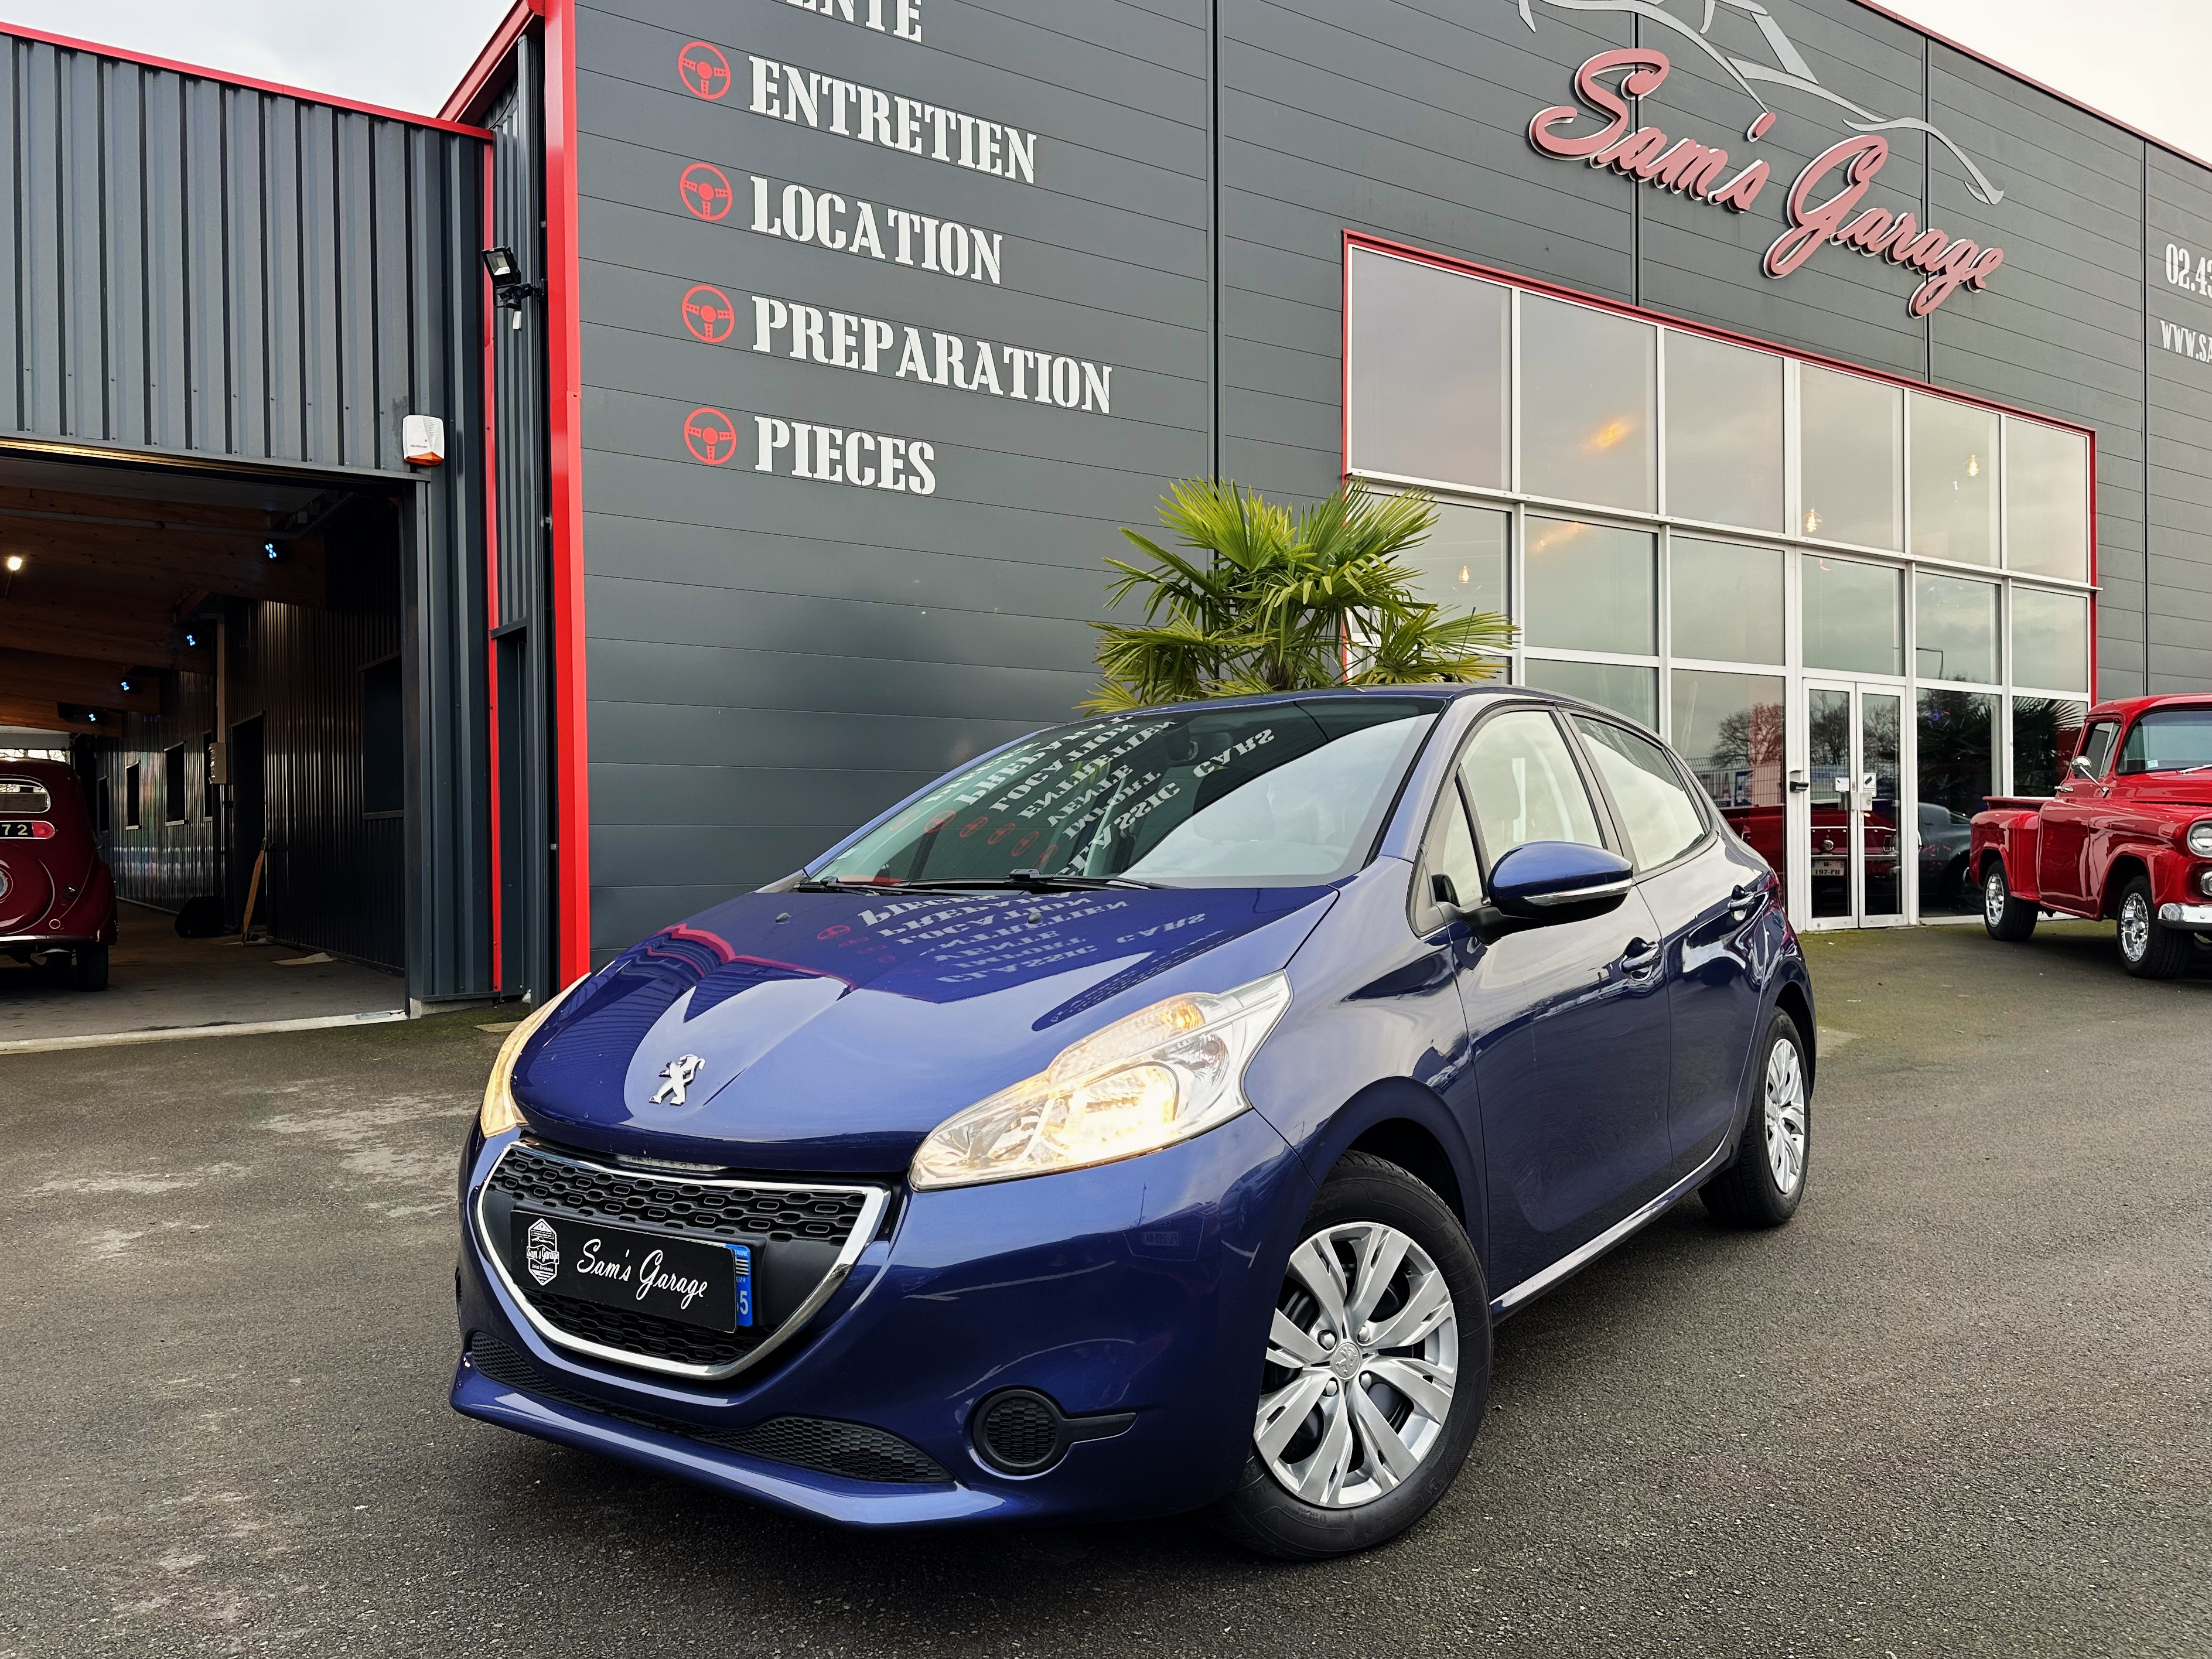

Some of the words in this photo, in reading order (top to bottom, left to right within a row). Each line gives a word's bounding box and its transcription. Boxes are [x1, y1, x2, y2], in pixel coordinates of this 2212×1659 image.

[748, 55, 1037, 184] ENTRETIEN
[750, 175, 1003, 285] LOCATION
[1529, 48, 1776, 213] Sam's
[1763, 135, 2004, 319] Garage
[752, 295, 1112, 414] PREPARATION
[753, 415, 936, 496] PIECES
[576, 1238, 631, 1282] Sam's
[636, 1250, 708, 1310] Garage
